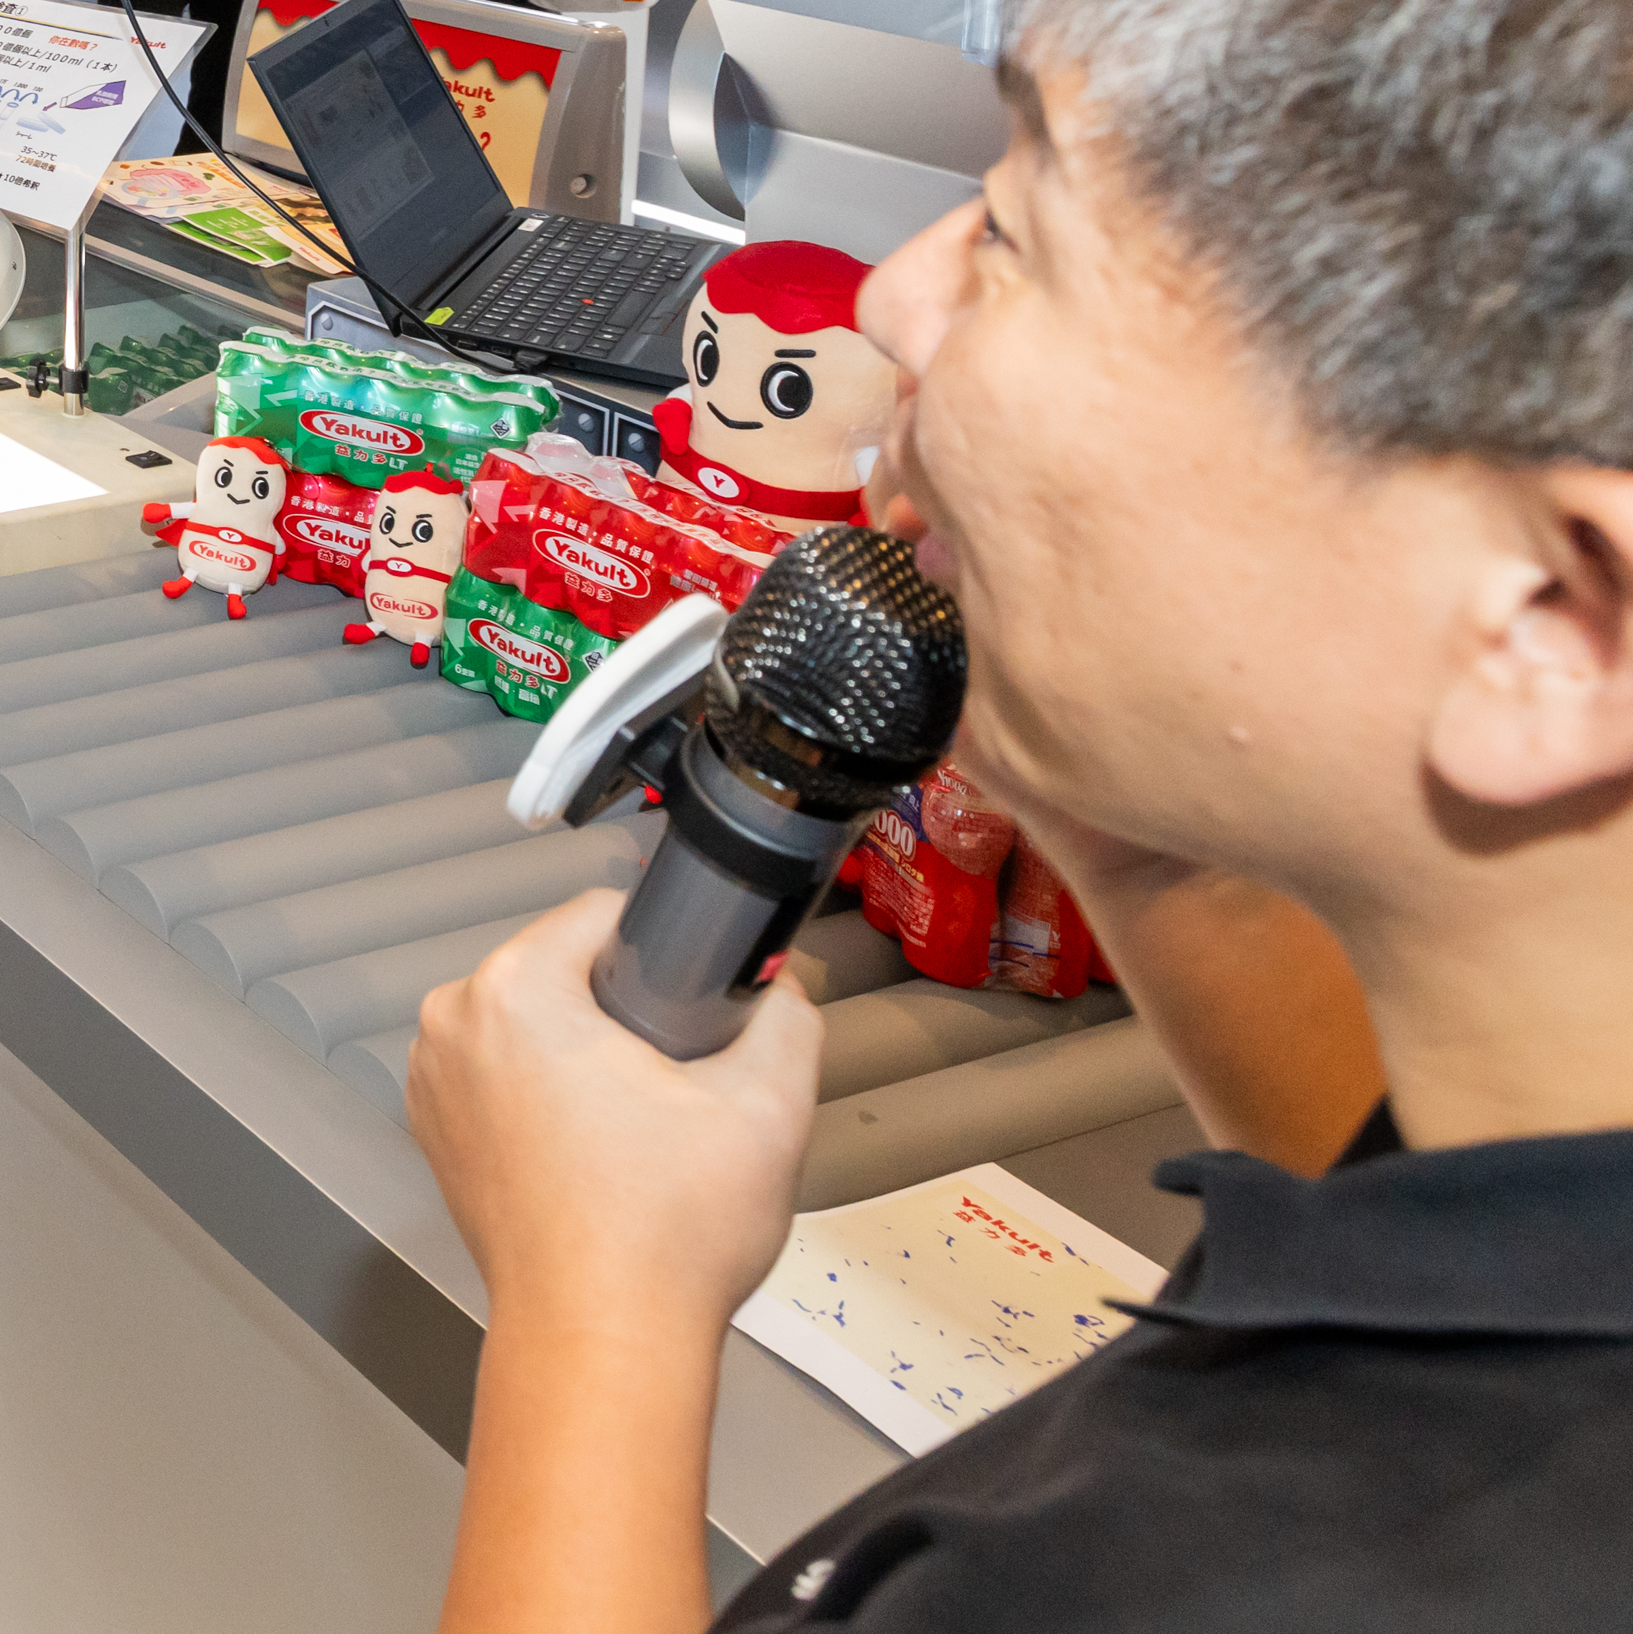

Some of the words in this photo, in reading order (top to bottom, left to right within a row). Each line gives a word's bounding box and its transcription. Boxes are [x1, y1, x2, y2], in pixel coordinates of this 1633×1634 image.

[130, 36, 167, 50] Yault
[319, 415, 407, 452] Yakult
[712, 475, 725, 488] Y
[304, 522, 370, 552] Yaku
[198, 544, 247, 569] Yakult
[552, 537, 631, 589] Yakult
[564, 571, 613, 602] 益力多
[376, 595, 427, 617] Yakult
[486, 627, 555, 674] Yakult
[952, 1209, 1029, 1258] 益力多
[961, 1196, 1054, 1263] Yakult
